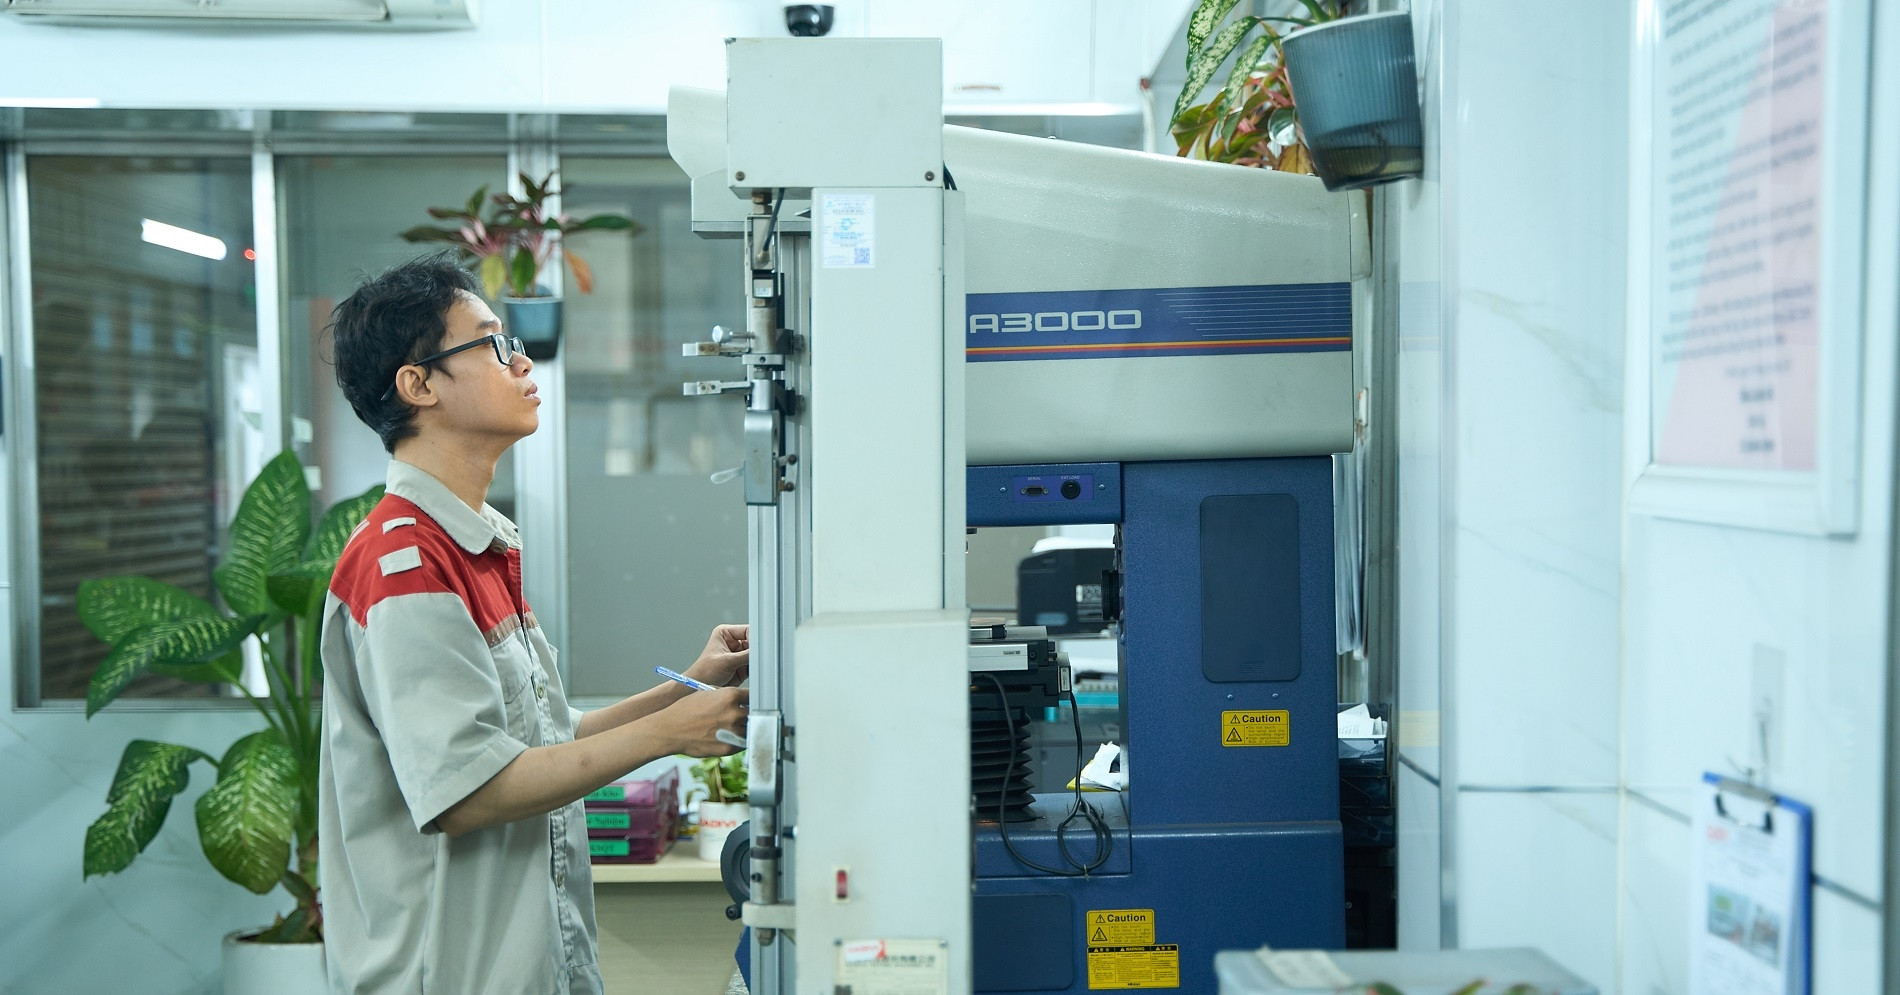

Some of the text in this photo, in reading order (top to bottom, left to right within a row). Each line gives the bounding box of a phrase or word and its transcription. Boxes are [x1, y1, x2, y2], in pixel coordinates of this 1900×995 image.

[969, 309, 1142, 334] A3000
[1242, 714, 1281, 723] Caution
[1107, 913, 1146, 922] Caution
